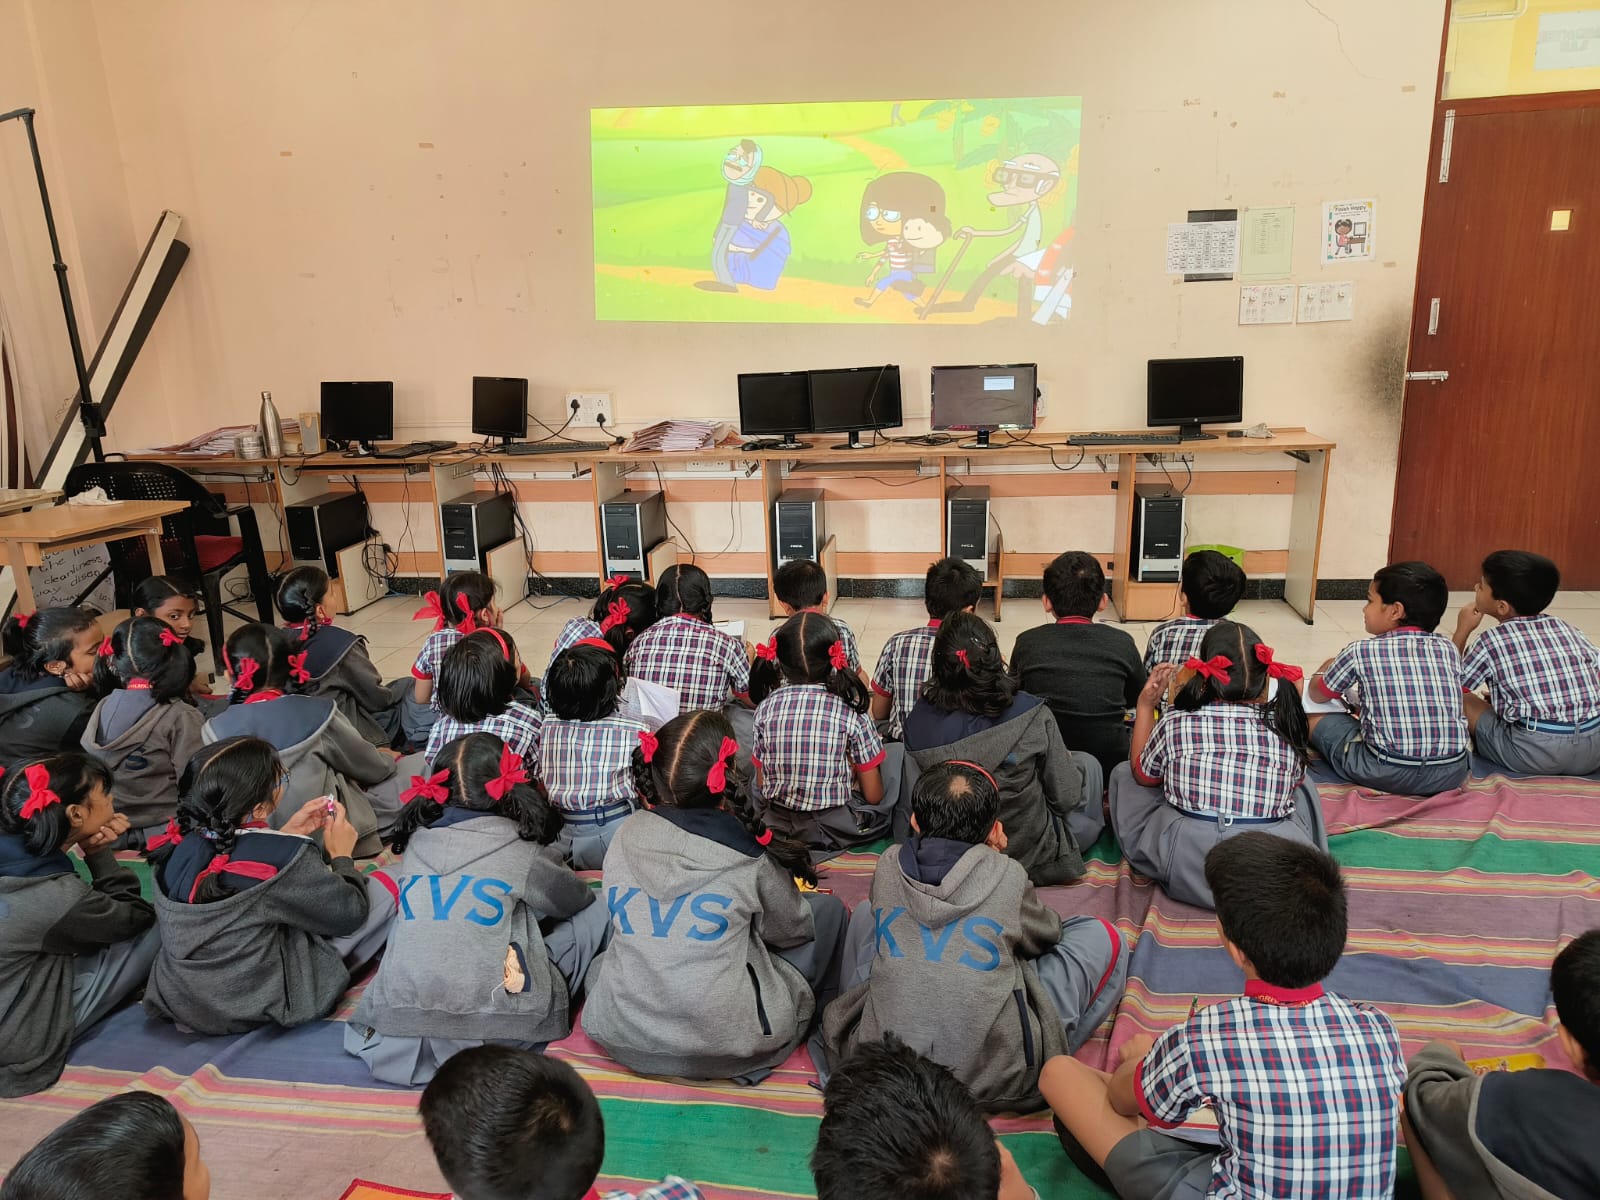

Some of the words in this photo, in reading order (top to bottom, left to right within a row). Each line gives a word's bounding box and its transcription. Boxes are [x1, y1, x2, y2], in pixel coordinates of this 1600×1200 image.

[398, 875, 513, 927] KVS
[607, 886, 734, 942] KVS
[875, 905, 1005, 972] KVS
